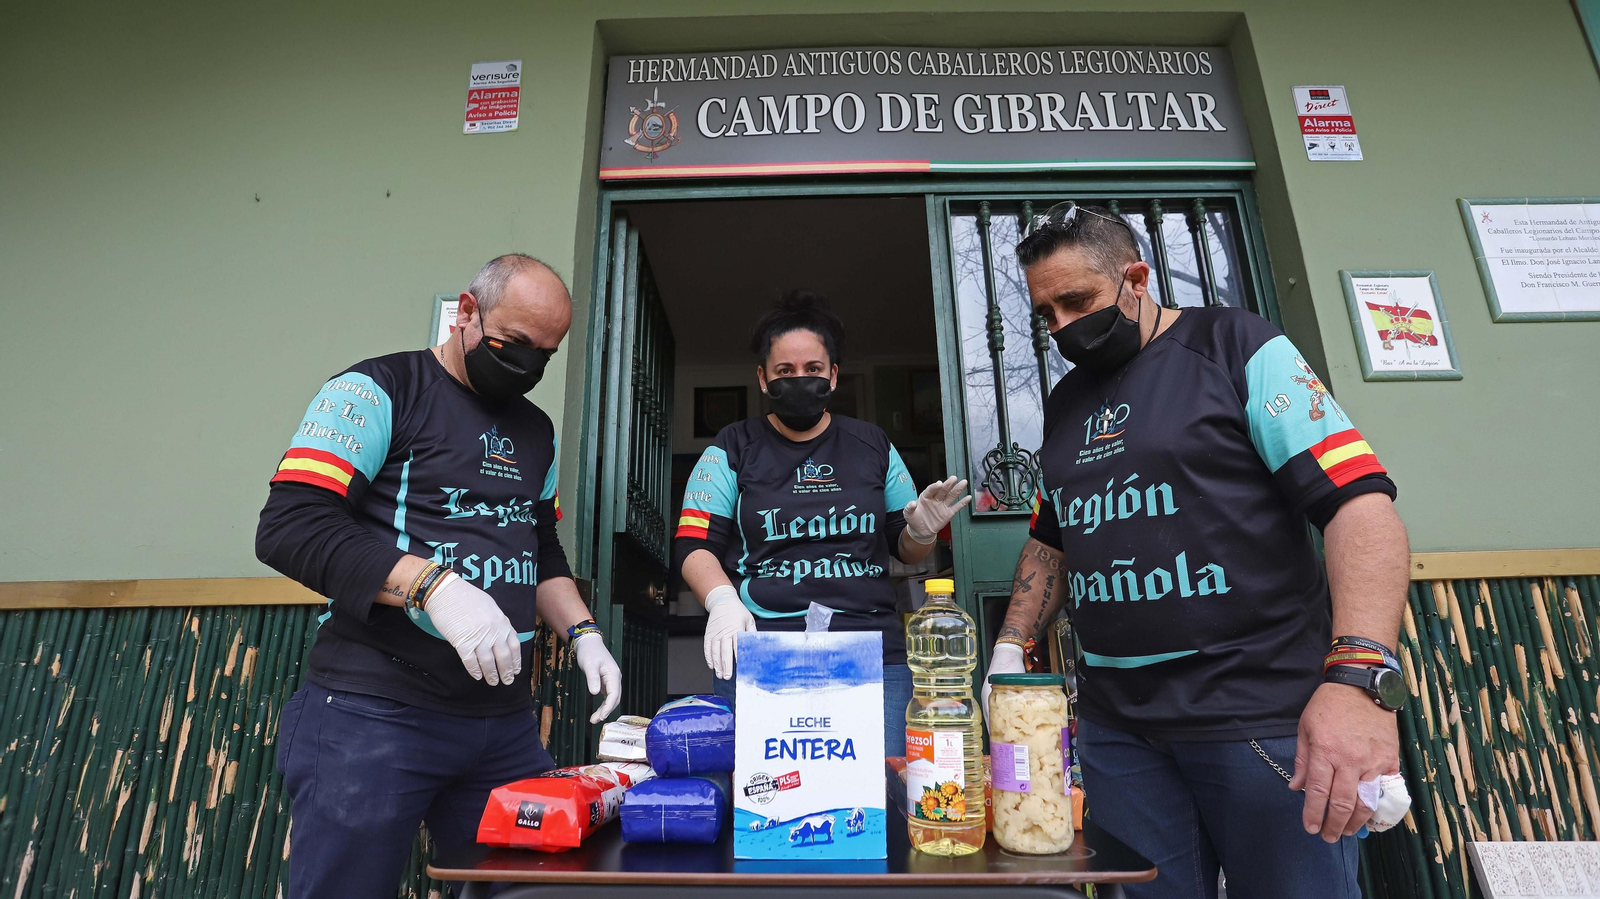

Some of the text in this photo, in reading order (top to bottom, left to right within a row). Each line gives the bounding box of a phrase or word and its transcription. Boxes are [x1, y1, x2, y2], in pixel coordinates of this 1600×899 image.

[627, 50, 1213, 83] HERMANDAD ANTIGUOS CABALLEROS LEGIONARIOS
[471, 72, 520, 81] verisure
[469, 90, 518, 100] Alarma
[1304, 99, 1339, 113] Direct
[697, 91, 1227, 138] CAMPO DE GIBRALTAR
[1303, 118, 1351, 127] Alarma
[1523, 228, 1562, 236] Legionarios
[1546, 258, 1560, 266] José
[1562, 258, 1586, 266] Ignacio
[312, 398, 367, 428] De La
[1265, 394, 1291, 418] 19
[297, 421, 363, 454] Muerte
[1114, 446, 1124, 454] años
[696, 468, 712, 482] La
[1049, 472, 1180, 535] Legión
[756, 504, 876, 542] Legión
[752, 552, 884, 586] Española
[790, 717, 831, 728] LECHE
[764, 737, 856, 761] ENTERA
[750, 775, 769, 785] ORIGEN
[780, 775, 790, 786] PLS
[518, 818, 540, 828] GALLO
